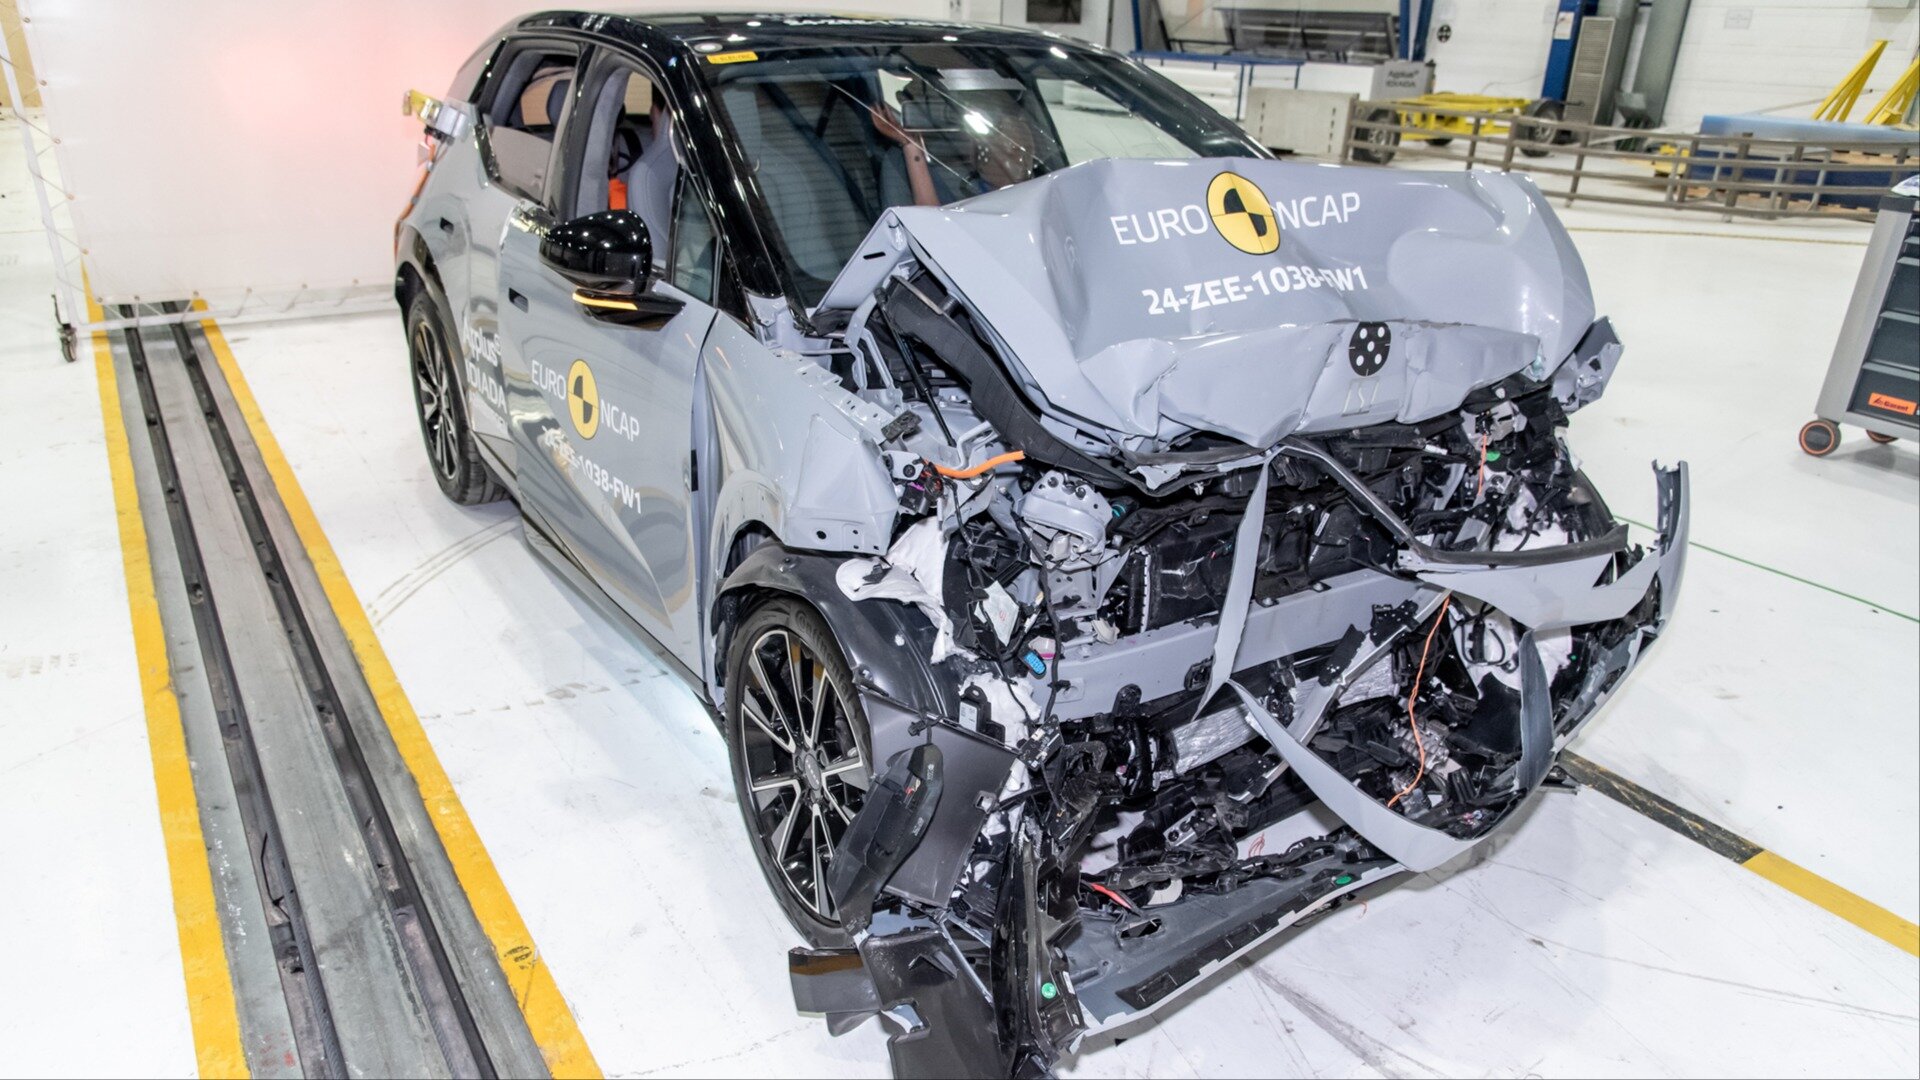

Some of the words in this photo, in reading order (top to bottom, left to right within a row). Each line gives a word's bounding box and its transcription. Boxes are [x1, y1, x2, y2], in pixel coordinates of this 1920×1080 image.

[1110, 204, 1208, 245] EURO
[1270, 192, 1361, 230] NCAP
[531, 360, 567, 400] EURO
[600, 399, 639, 442] NCAP
